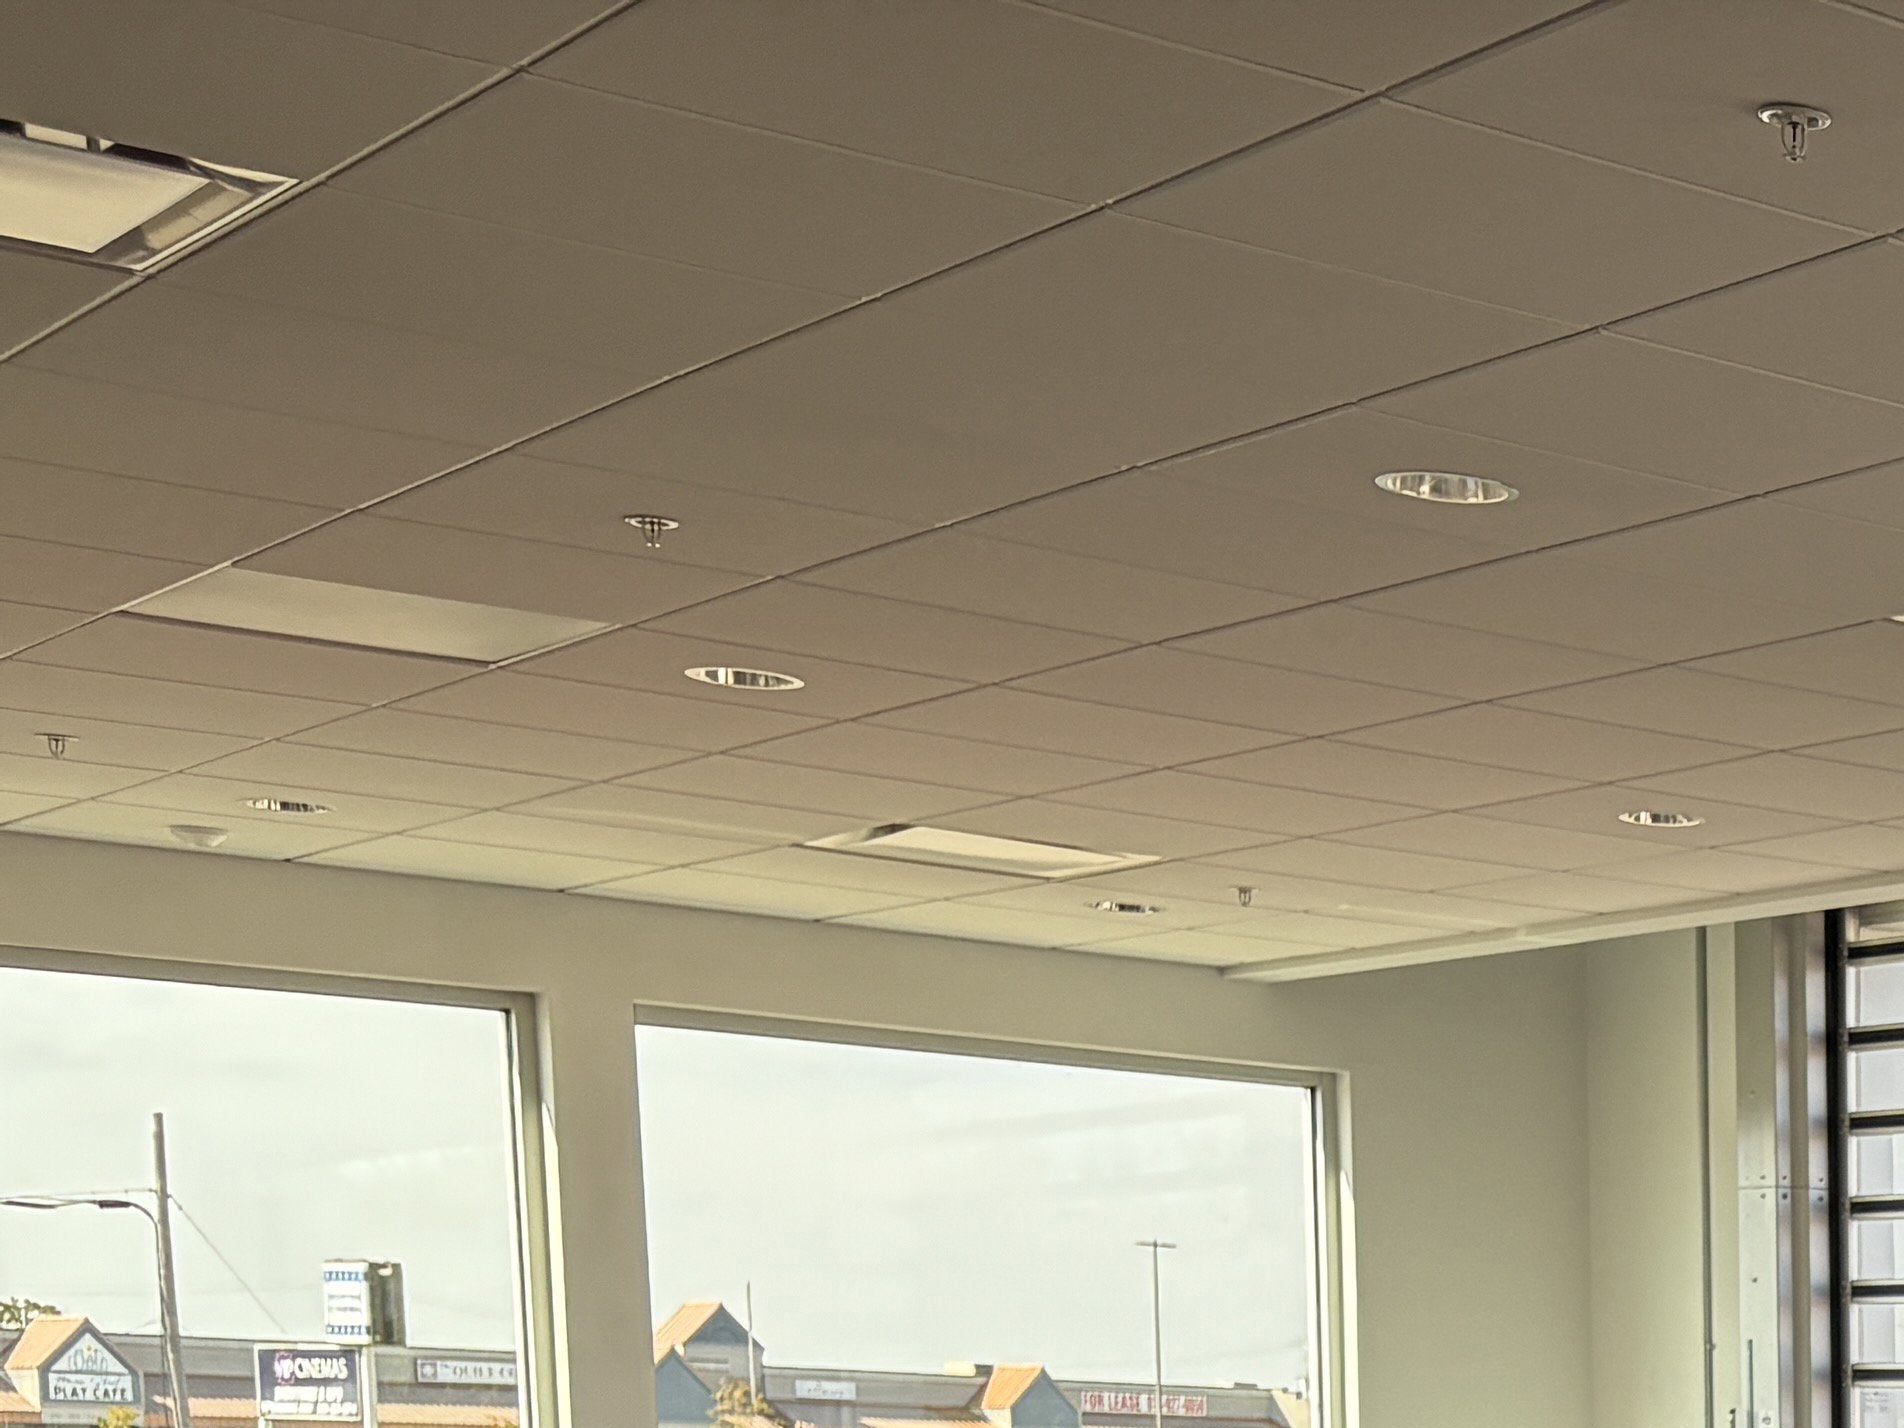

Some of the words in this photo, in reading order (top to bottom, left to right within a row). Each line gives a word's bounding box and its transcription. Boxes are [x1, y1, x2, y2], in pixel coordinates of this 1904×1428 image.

[294, 1356, 348, 1380] CINEMAS
[53, 1384, 87, 1400] PLAY
[93, 1386, 129, 1401] CAFE
[1081, 1391, 1105, 1410] FOR
[1107, 1392, 1142, 1413] LEASE
